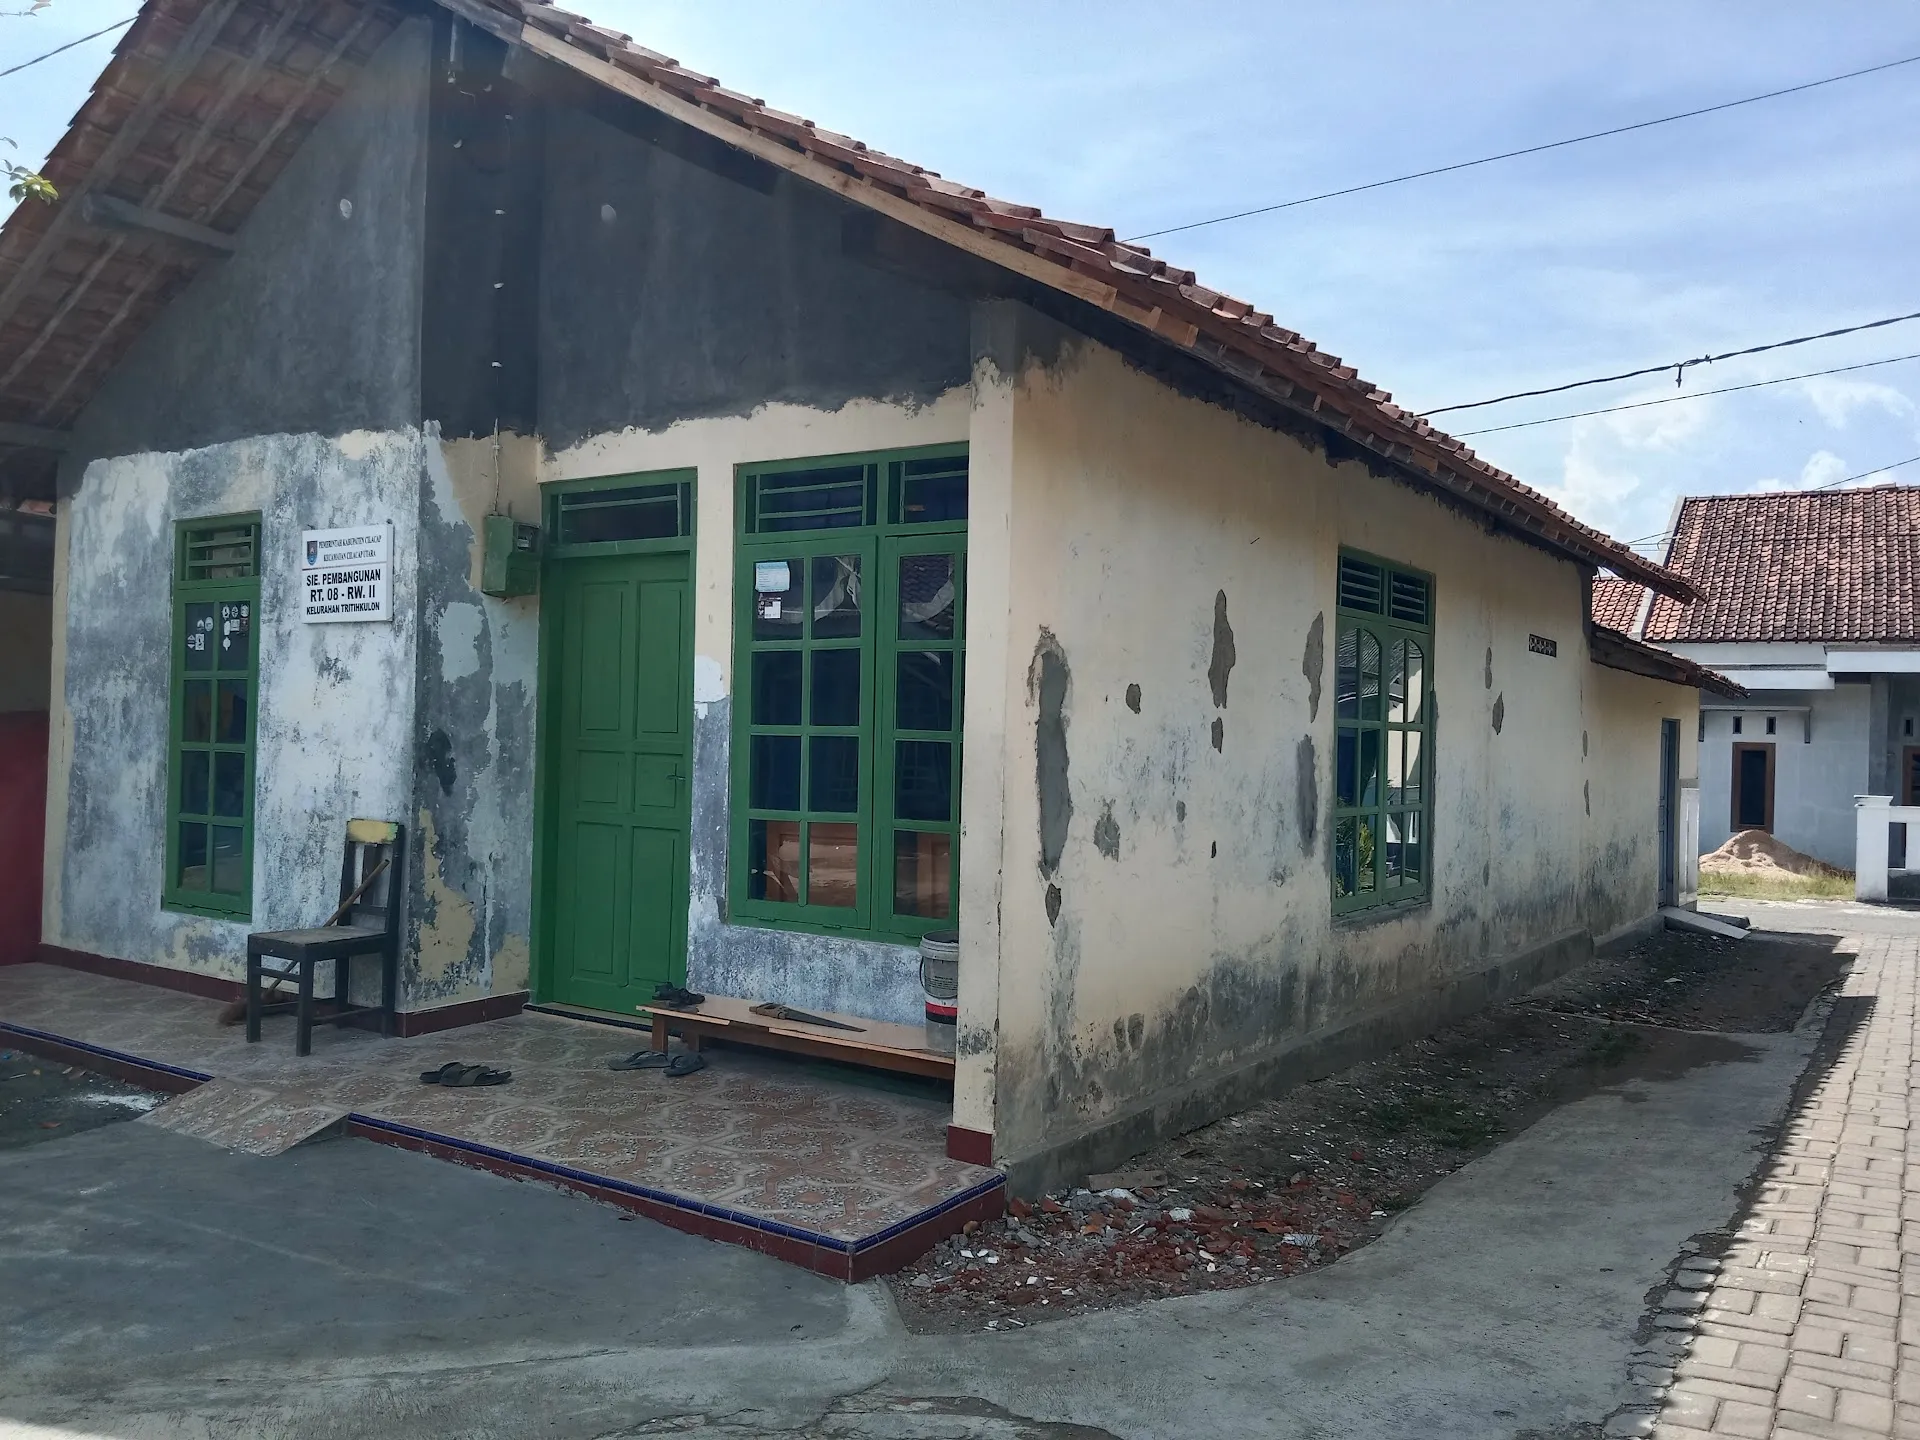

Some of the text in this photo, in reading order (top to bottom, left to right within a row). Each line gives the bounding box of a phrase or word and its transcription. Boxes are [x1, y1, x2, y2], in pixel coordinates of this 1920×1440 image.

[322, 569, 381, 585] PEMBANGUNAN
[310, 589, 324, 602] RT.
[327, 588, 338, 600] 08
[347, 586, 365, 599] RW.
[306, 604, 340, 615] KELURAHAN
